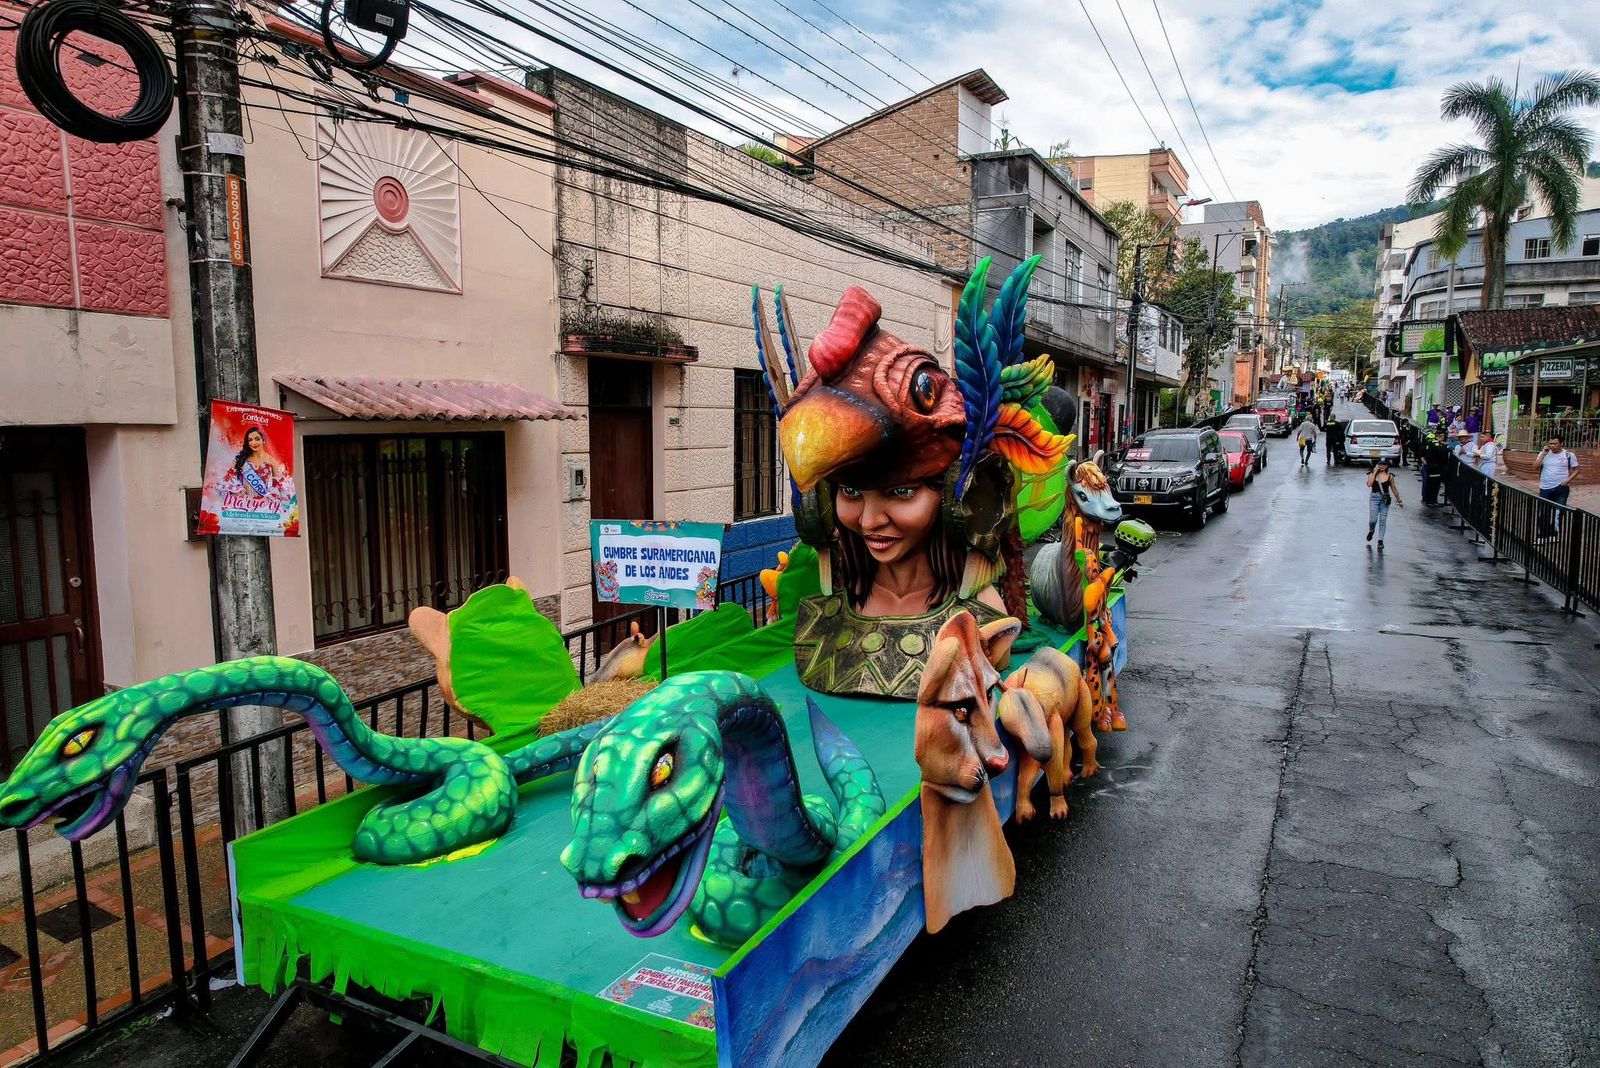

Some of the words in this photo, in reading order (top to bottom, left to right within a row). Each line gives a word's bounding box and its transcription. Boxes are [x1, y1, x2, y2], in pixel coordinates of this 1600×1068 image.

[230, 180, 241, 260] 65920166
[1540, 361, 1571, 371] PIZZERIA
[604, 546, 637, 560] CUMBRE
[640, 548, 716, 564] SURAMERICANA
[625, 565, 637, 578] DE
[640, 565, 656, 578] LOS
[659, 566, 689, 581] ANDES
[637, 968, 668, 981] CUMBRE
[635, 974, 645, 982] EN
[645, 977, 677, 990] DEFENSA
[675, 984, 687, 993] DE
[686, 987, 702, 997] LOS
